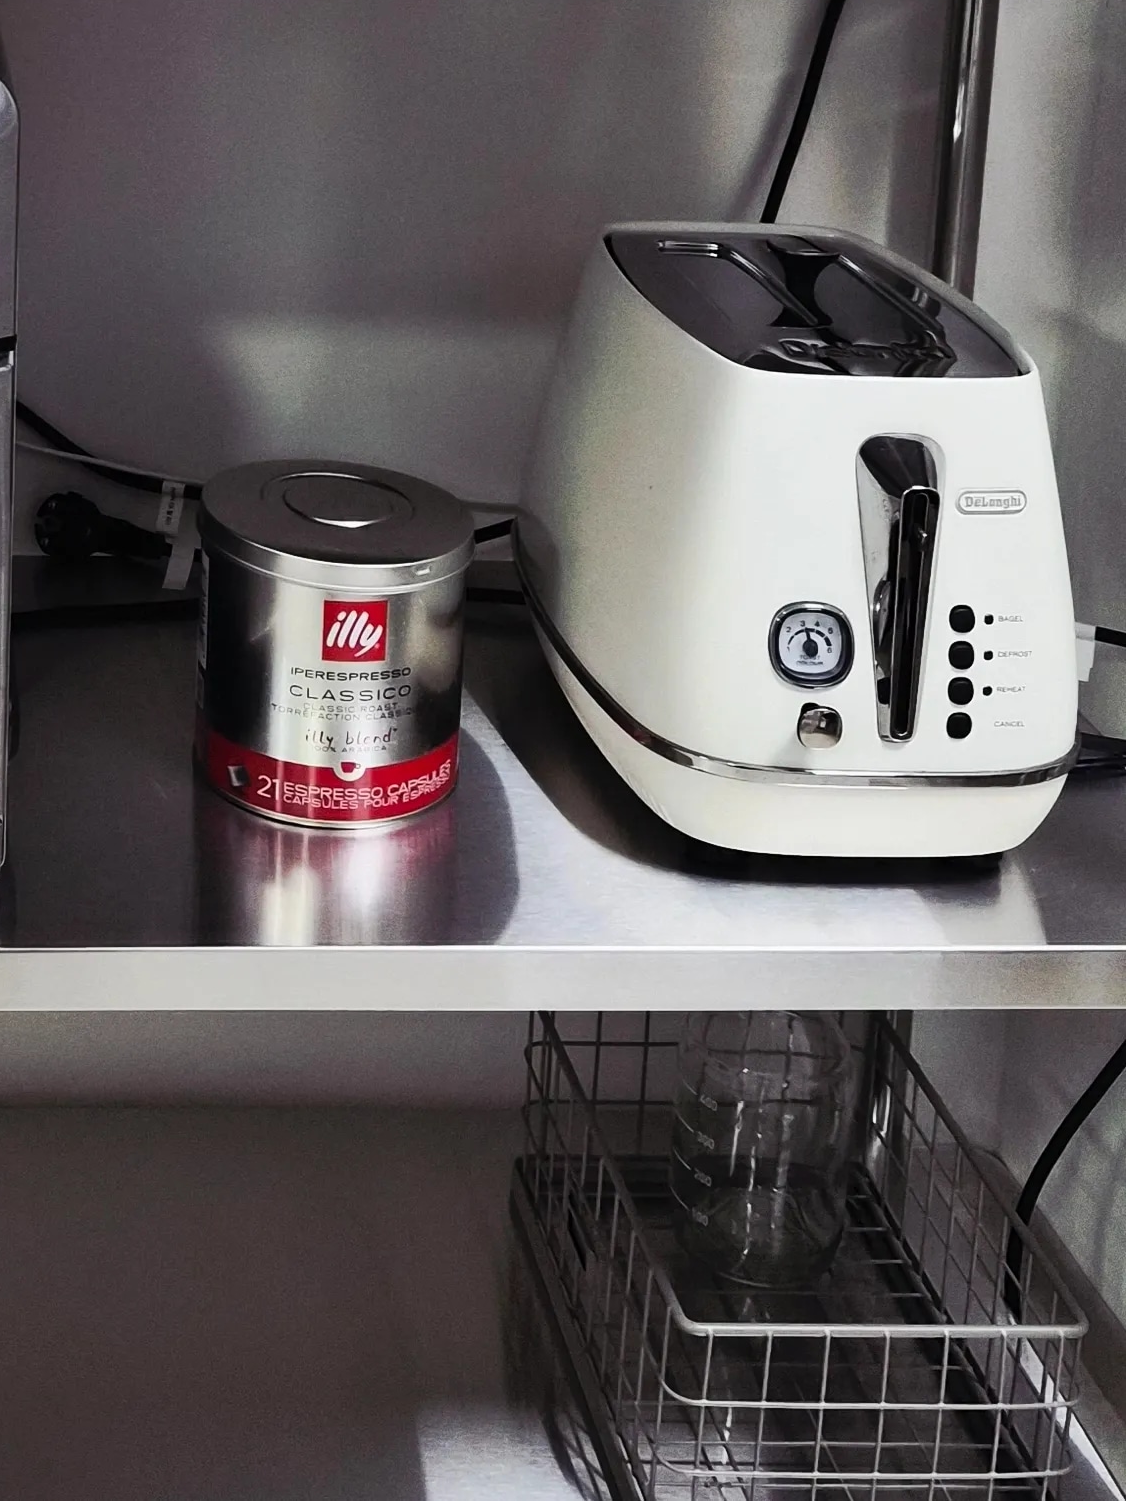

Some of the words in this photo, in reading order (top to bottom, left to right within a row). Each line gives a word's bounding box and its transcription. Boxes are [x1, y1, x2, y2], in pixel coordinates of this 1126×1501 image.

[998, 615, 1024, 623] BAGEL
[325, 609, 384, 657] illy
[290, 667, 412, 682] IPERESPRESSO
[289, 685, 412, 702] CLASSICO
[303, 702, 356, 714] CLASSIC
[360, 701, 399, 713] ROAST
[306, 728, 334, 749] illy
[257, 775, 280, 801] 21
[283, 781, 383, 801] ESPRESSO
[387, 759, 452, 797] CAPSULES
[283, 795, 359, 810] CAPSULES
[364, 795, 399, 809] POUR
